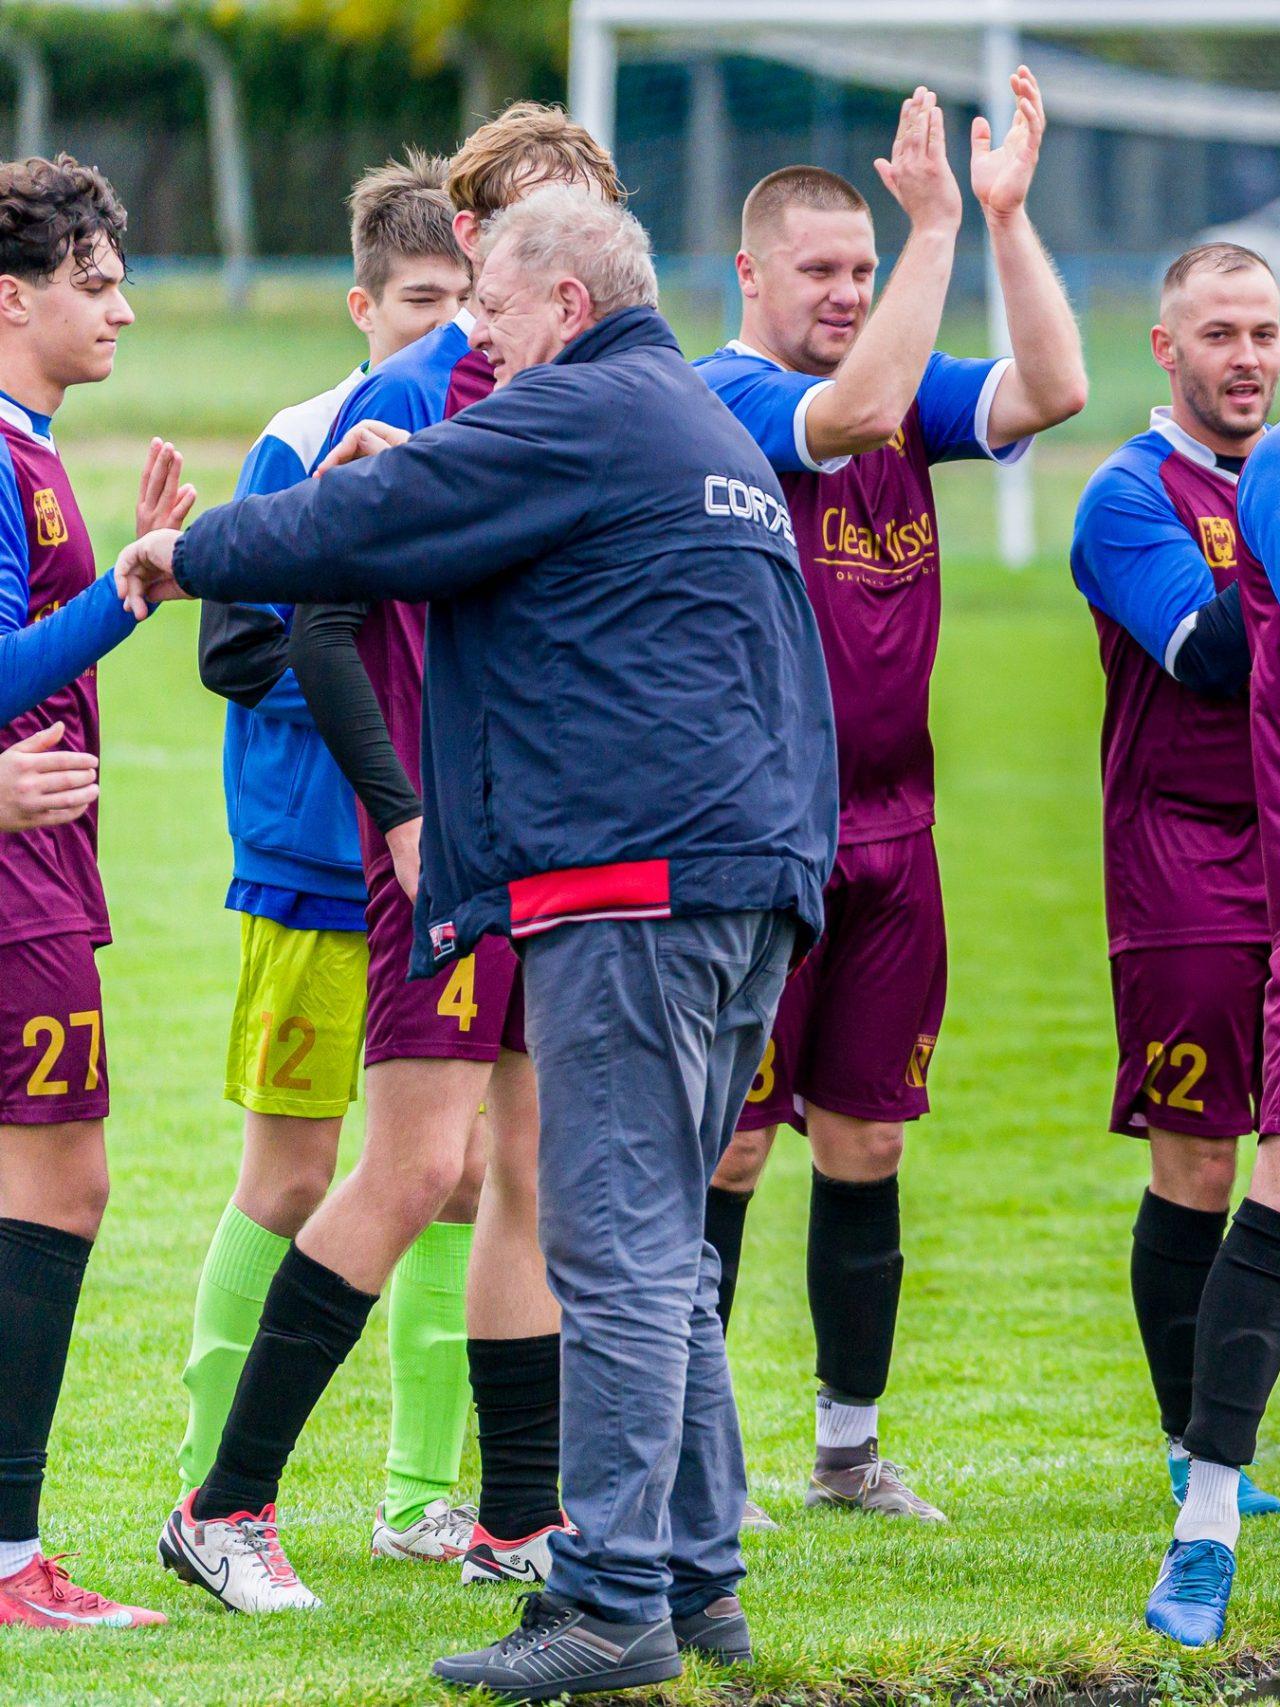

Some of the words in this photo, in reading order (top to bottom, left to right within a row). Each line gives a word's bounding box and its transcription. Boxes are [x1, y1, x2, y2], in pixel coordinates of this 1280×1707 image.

[437, 953, 478, 1032] 4
[23, 1010, 100, 1096] 27
[256, 1012, 316, 1090] 12
[1143, 1041, 1208, 1113] 22
